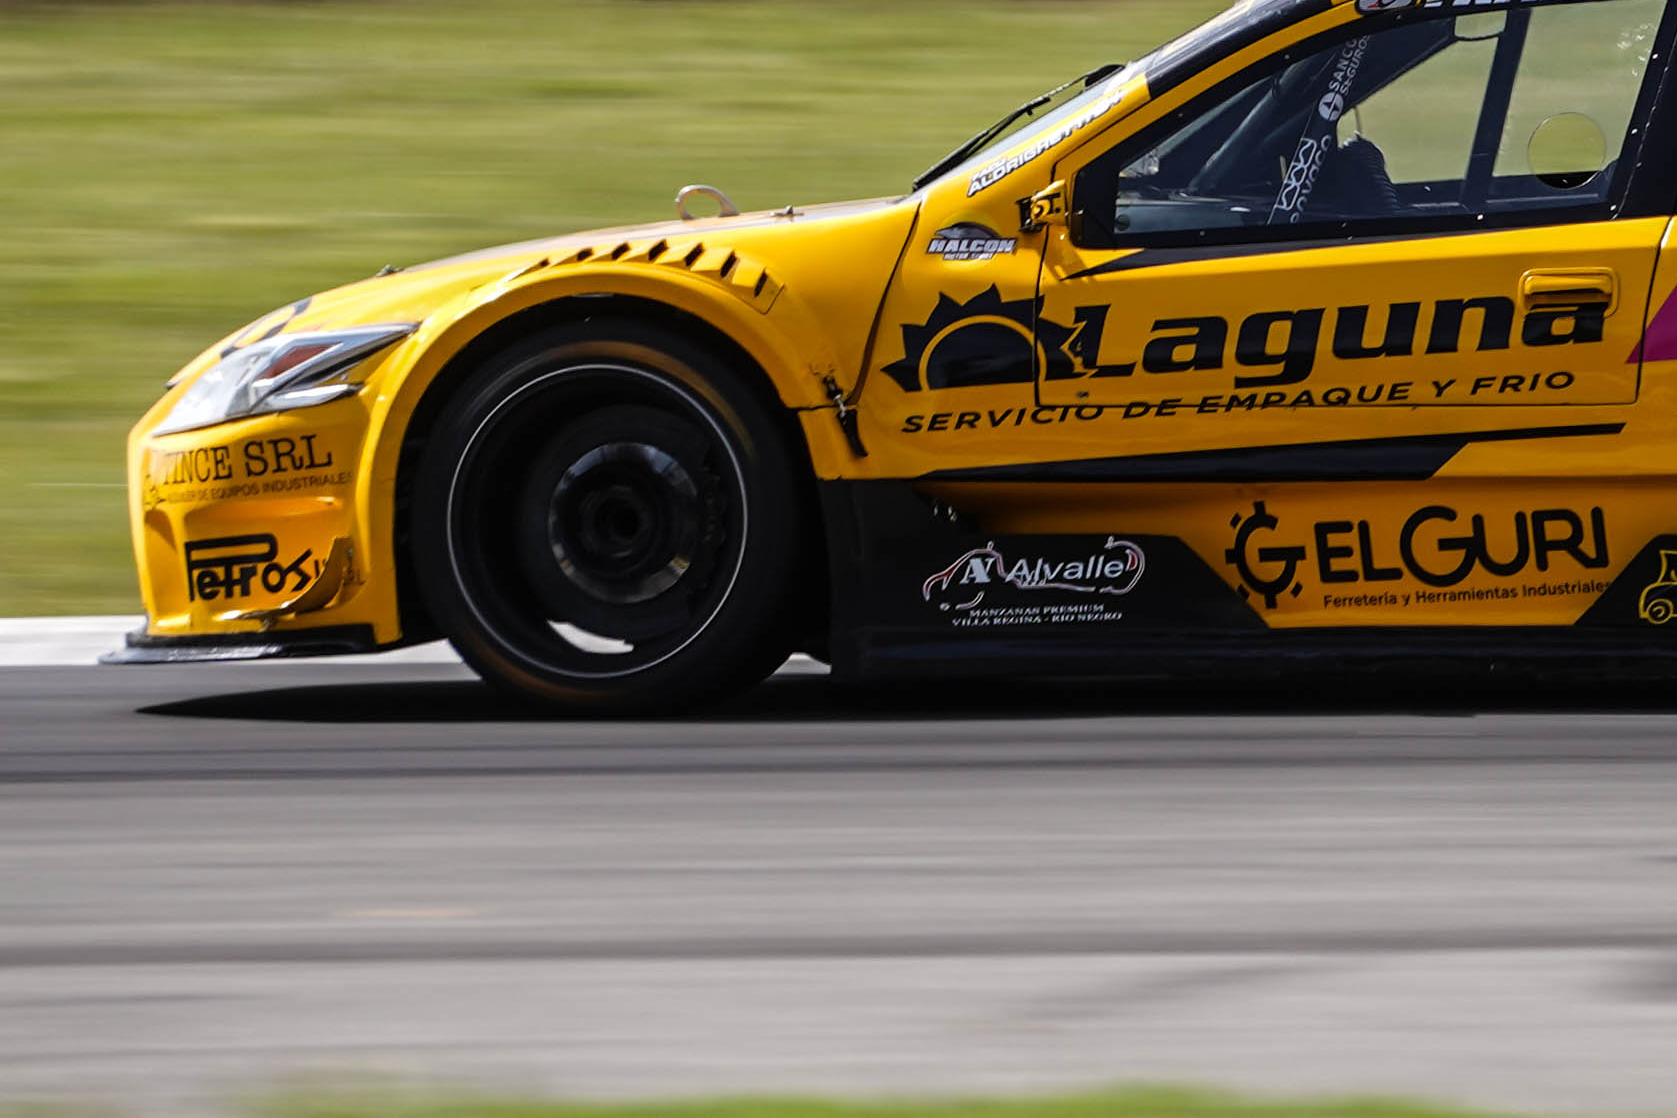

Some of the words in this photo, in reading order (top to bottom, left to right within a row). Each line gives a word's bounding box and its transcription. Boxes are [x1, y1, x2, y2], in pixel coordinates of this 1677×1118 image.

[927, 237, 1018, 254] HALCON
[1074, 293, 1606, 387] Laguna
[902, 404, 1104, 433] SERVICIO
[1122, 399, 1179, 419] DE
[1196, 382, 1411, 415] EMPAQUE
[1432, 379, 1458, 398] Y
[1471, 370, 1576, 395] FRIO
[244, 434, 333, 477] SRL
[1005, 555, 1124, 583] Alvalle
[1225, 501, 1610, 609] GELGURI
[1324, 590, 1398, 608] Ferretería
[1401, 594, 1411, 606] y
[1416, 588, 1519, 603] Herramientas
[1522, 580, 1612, 598] Industriales
